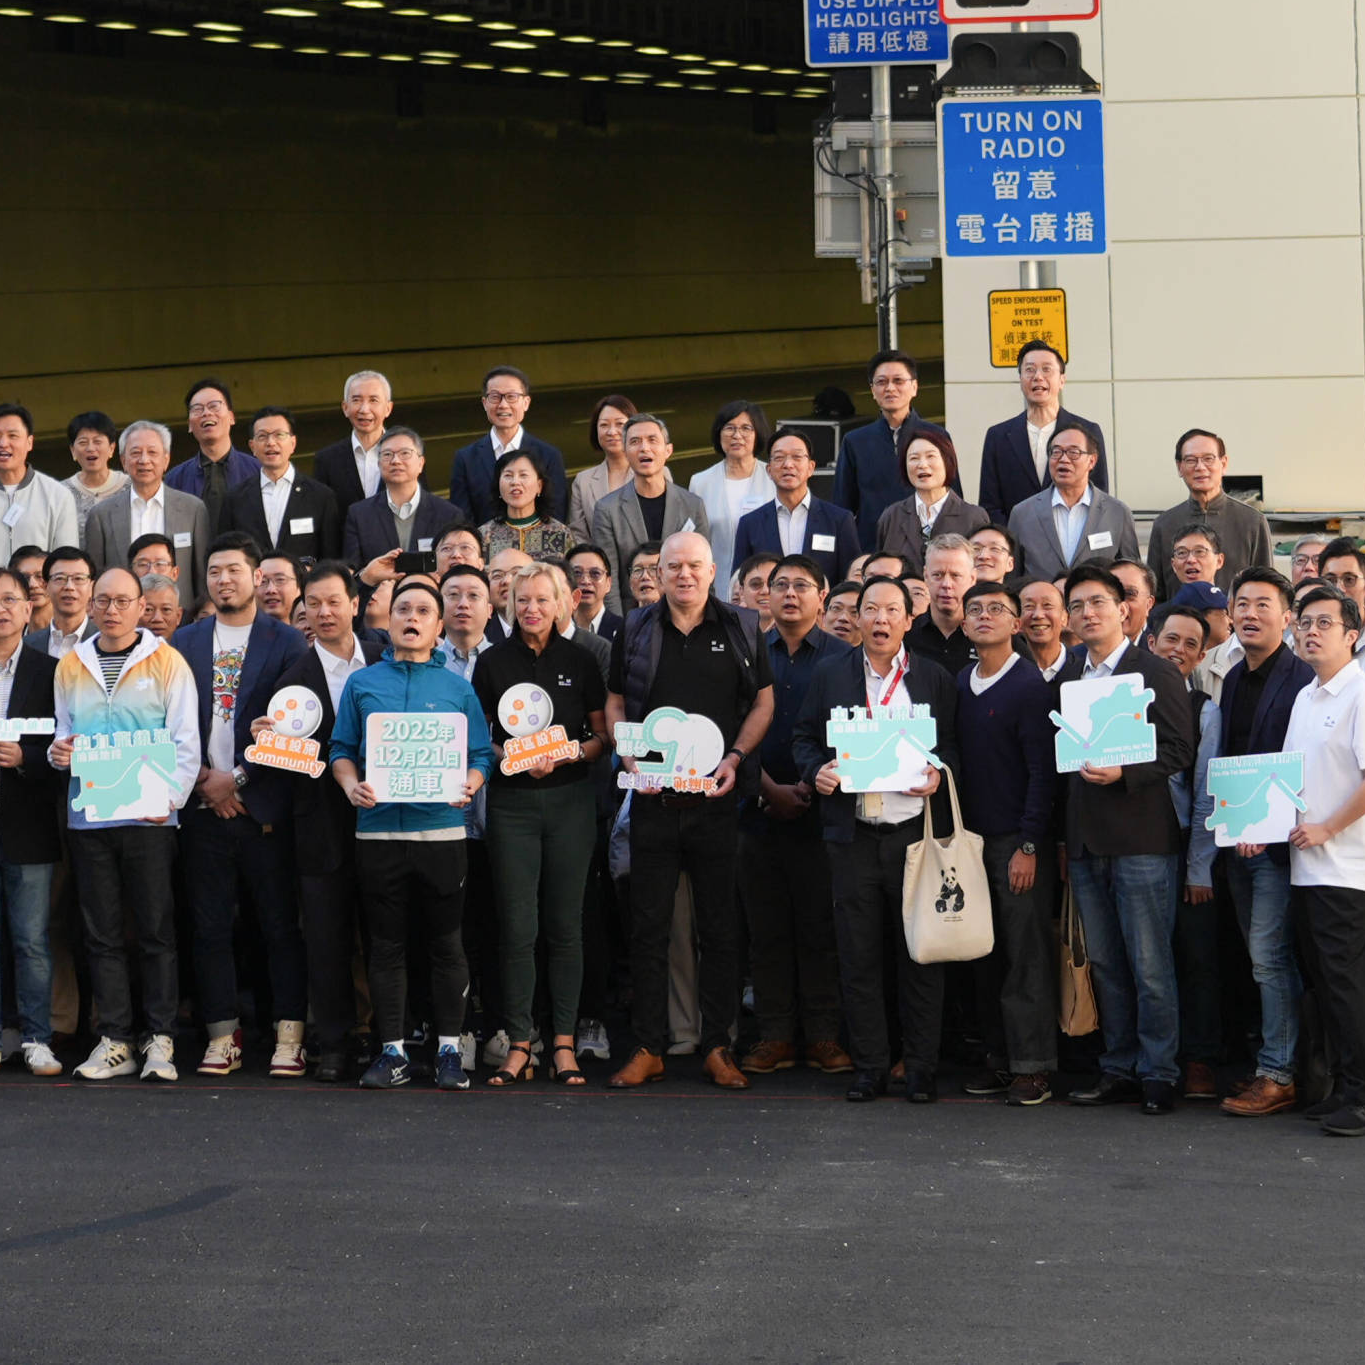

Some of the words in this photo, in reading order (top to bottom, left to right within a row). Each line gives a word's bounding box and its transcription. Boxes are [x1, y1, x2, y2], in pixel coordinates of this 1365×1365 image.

[815, 9, 940, 28] HEADLIGHTS
[827, 31, 929, 55] 請用低燈
[959, 111, 1034, 134] TURN
[1042, 110, 1082, 132] ON
[981, 136, 1066, 160] RADIO
[991, 170, 1057, 201] 留意
[955, 211, 1094, 244] 電台廣播
[992, 297, 1012, 305] SPEED
[1014, 308, 1041, 316] SYSTEM
[1011, 319, 1023, 327] ON
[1025, 318, 1044, 326] TEST
[381, 719, 455, 743] 2025年
[260, 732, 317, 756] 社區設施
[246, 748, 324, 777] Community
[375, 746, 460, 769] 12月21日
[502, 742, 577, 773] Community
[389, 771, 444, 798] 通車
